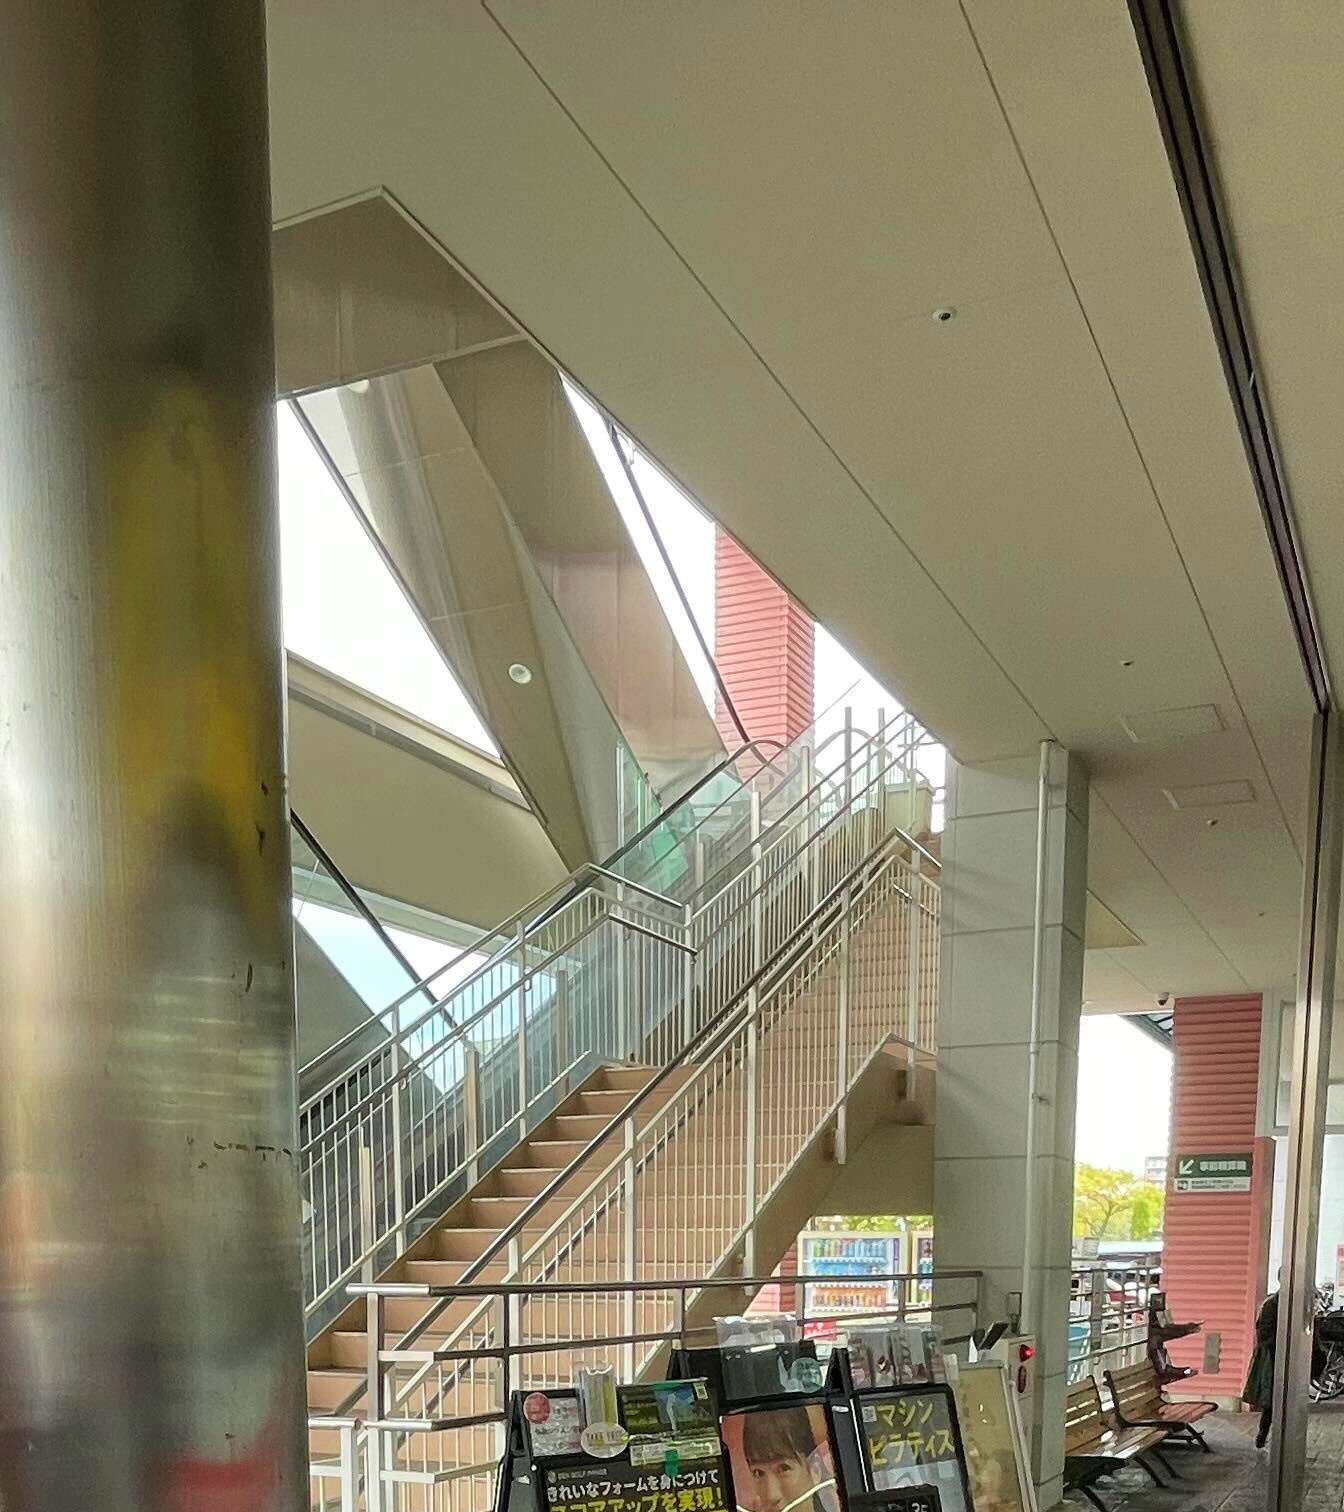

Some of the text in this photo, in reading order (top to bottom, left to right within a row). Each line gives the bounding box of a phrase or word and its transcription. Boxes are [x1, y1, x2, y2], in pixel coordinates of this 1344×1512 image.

[877, 1398, 933, 1427] マシン
[869, 1429, 955, 1465] ピラティス
